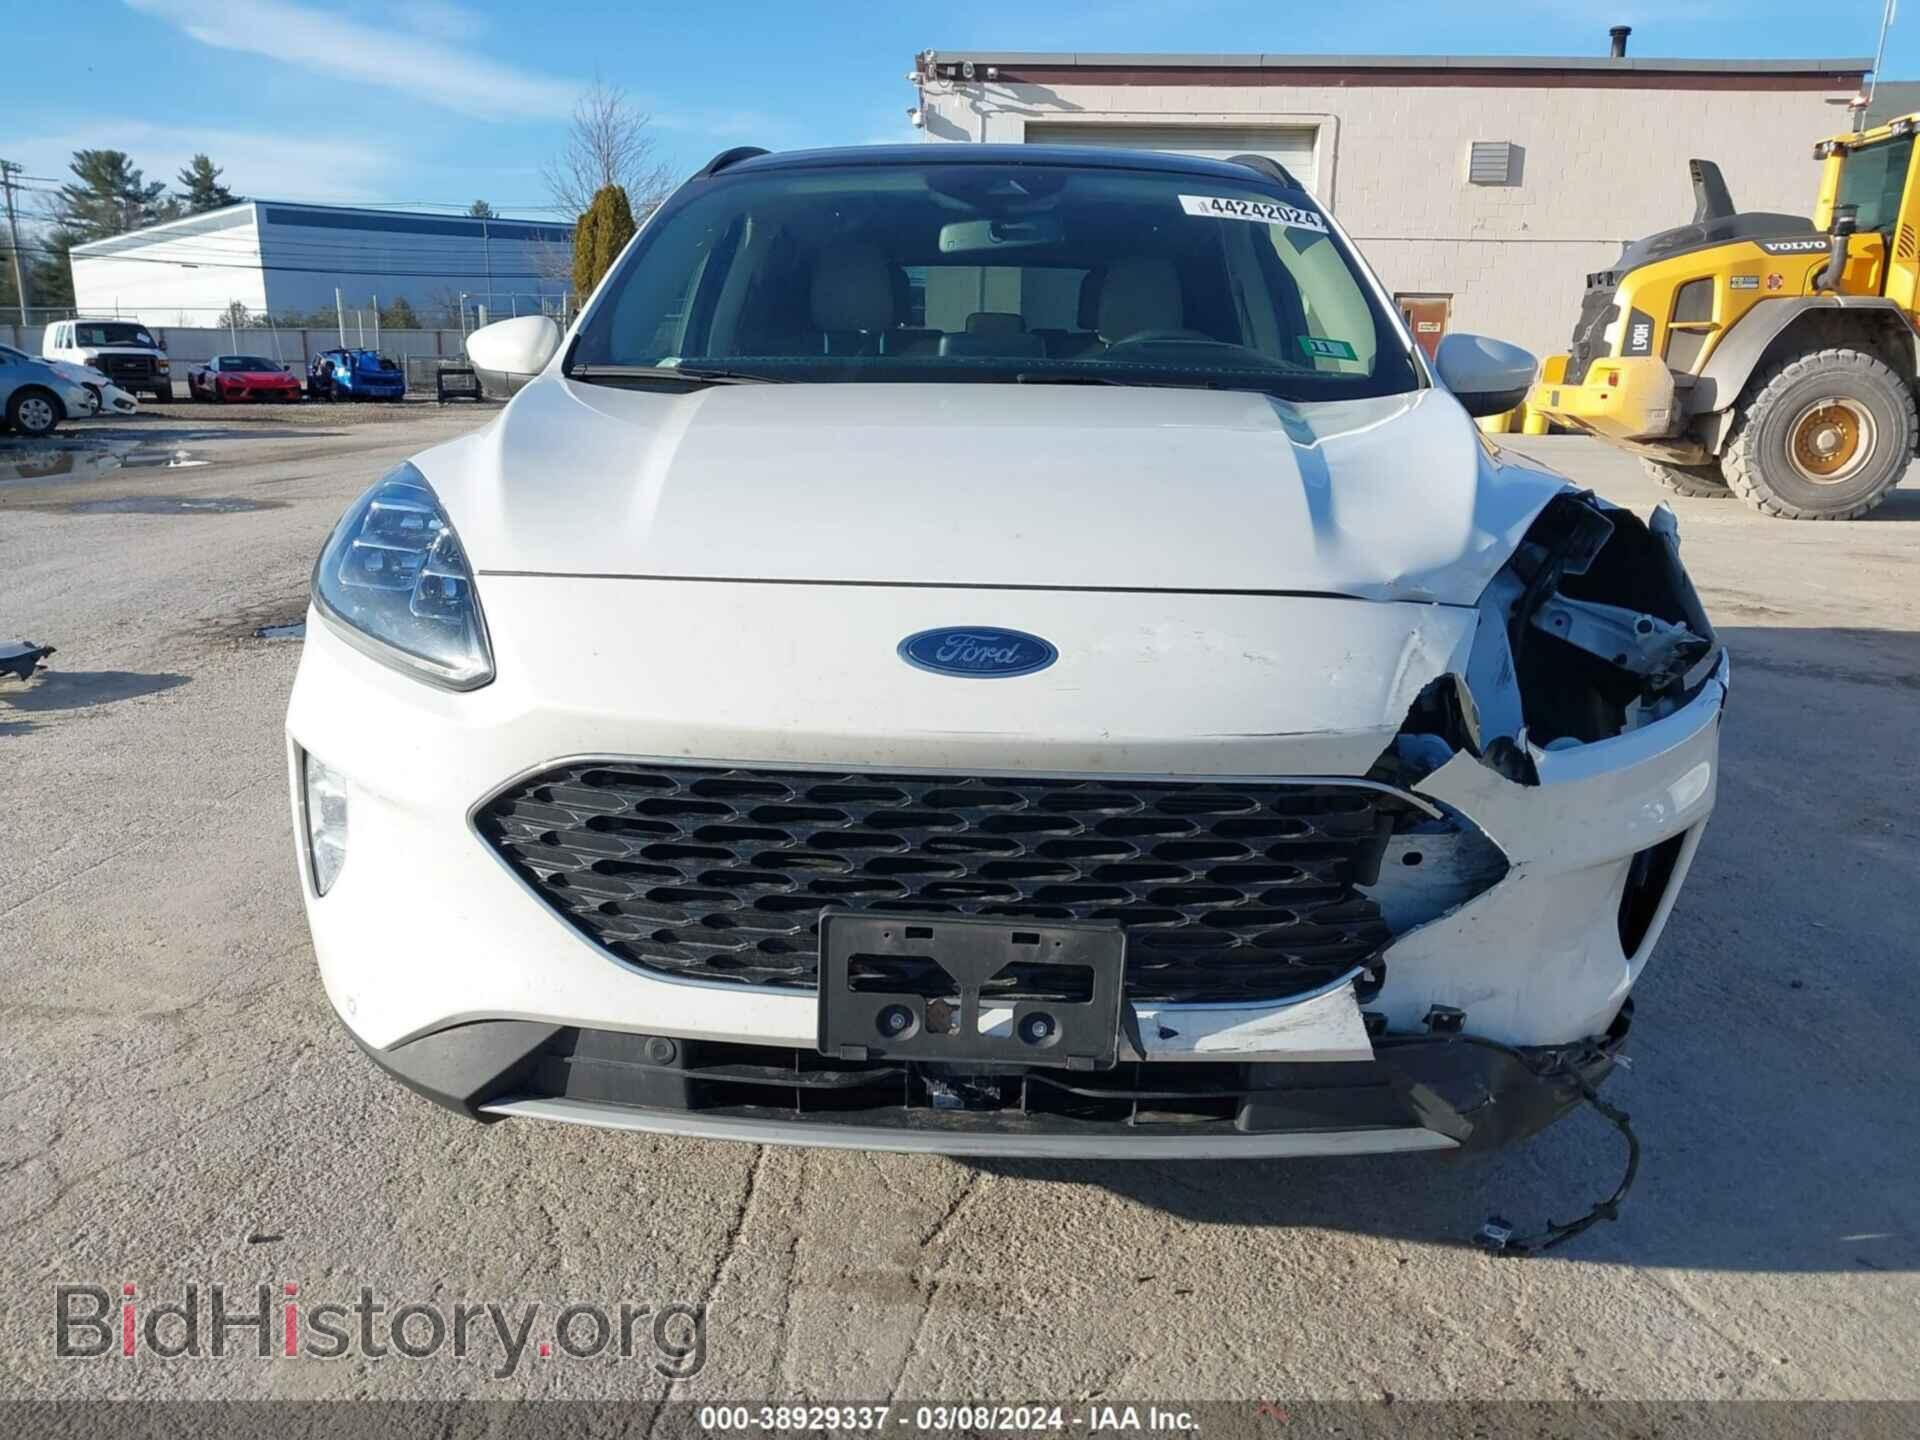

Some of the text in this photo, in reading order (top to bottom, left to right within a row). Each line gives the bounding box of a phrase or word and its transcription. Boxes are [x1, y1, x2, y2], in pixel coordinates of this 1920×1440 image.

[1210, 198, 1319, 228] 44242024
[1765, 240, 1827, 251] VOLVO
[1631, 324, 1649, 351] L90H
[935, 633, 1020, 664] Ford
